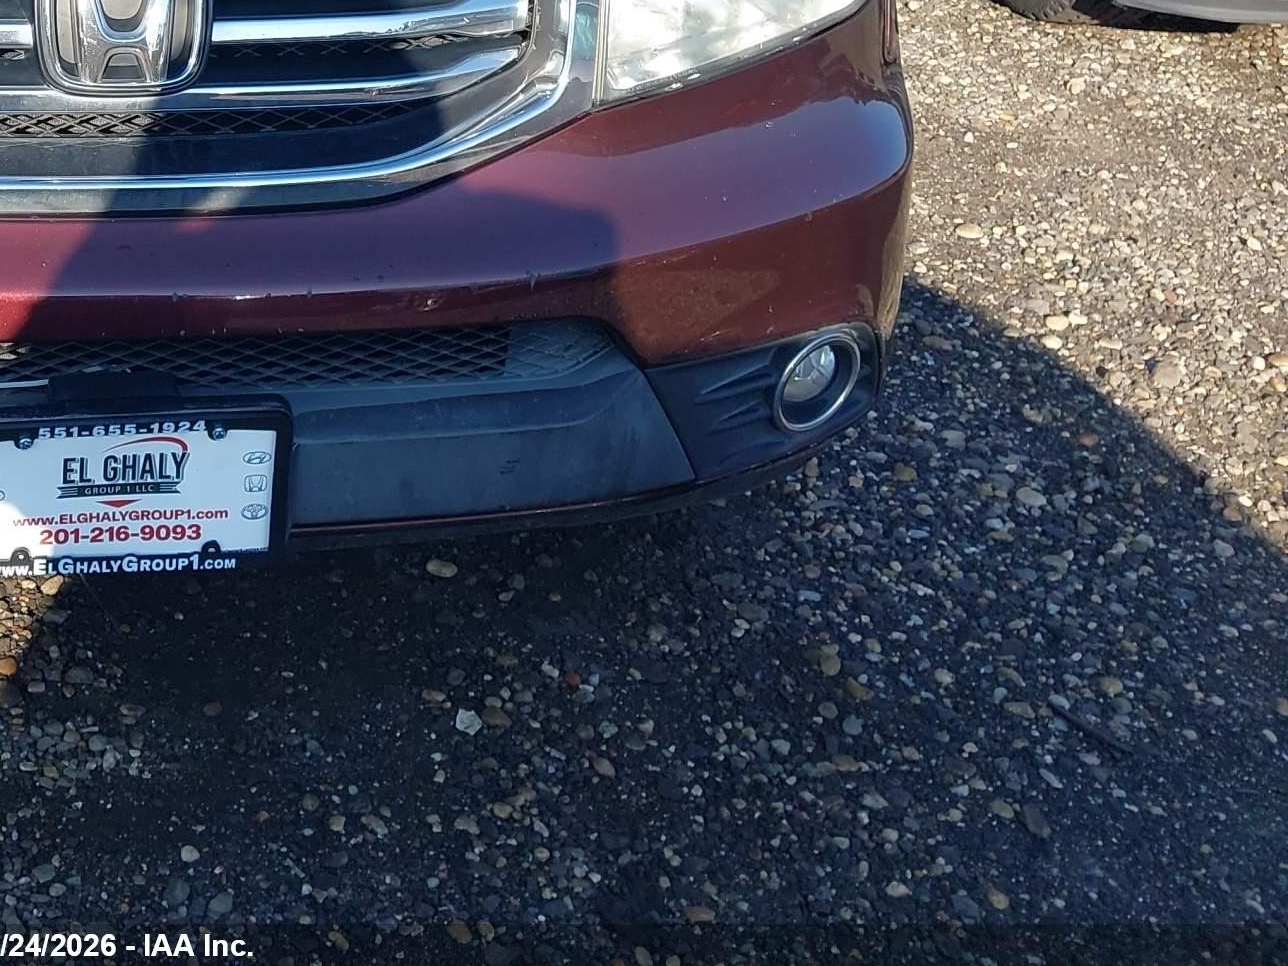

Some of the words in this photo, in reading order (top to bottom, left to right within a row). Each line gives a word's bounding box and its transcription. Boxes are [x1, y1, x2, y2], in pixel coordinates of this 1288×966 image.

[38, 420, 207, 439] 551-655-1924
[62, 456, 95, 485] EL
[103, 451, 190, 483] GHALY
[84, 485, 121, 496] GROUP
[135, 484, 154, 493] LLC
[12, 509, 229, 528] www.ELGHALYGROUP1.com
[39, 524, 203, 545] 201-216-9093
